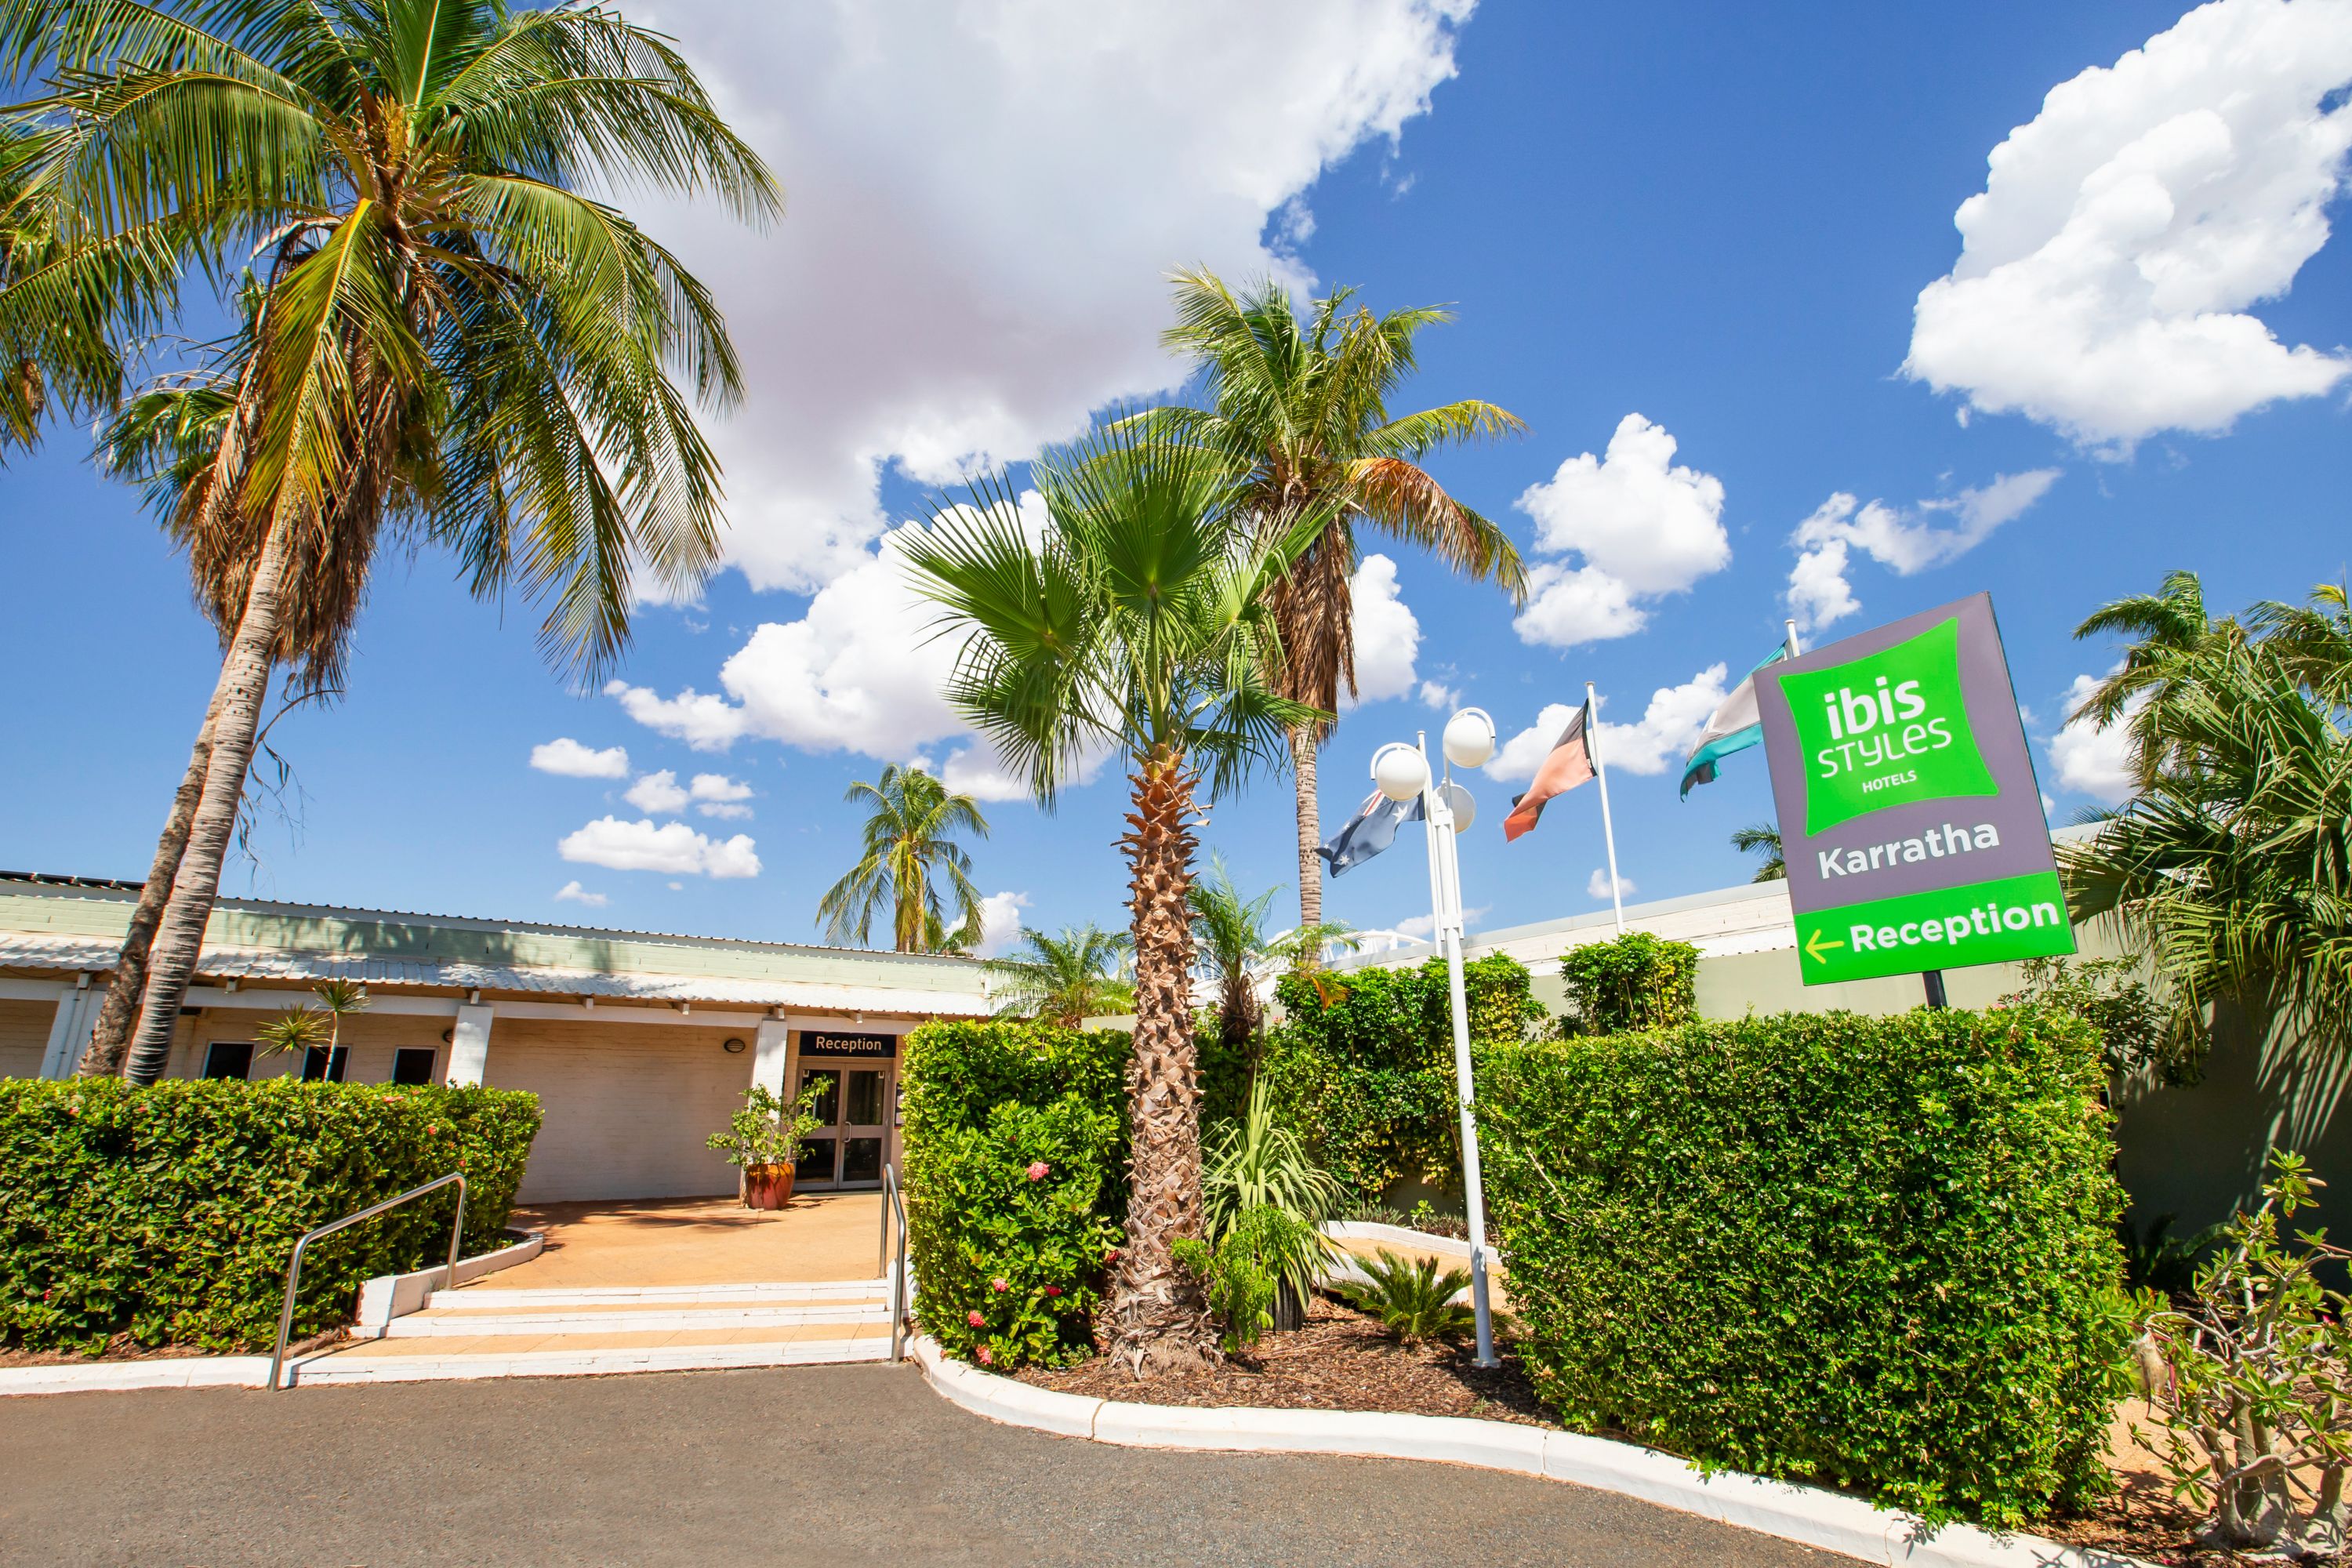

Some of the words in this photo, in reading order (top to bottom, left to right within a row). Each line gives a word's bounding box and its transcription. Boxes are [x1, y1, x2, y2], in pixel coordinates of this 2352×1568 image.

[1824, 676, 1926, 740] ibis
[1862, 769, 1918, 793] HOTELS
[1818, 822, 2001, 880] Karratha
[1849, 902, 2060, 953] Reception
[815, 1036, 882, 1053] Reception
